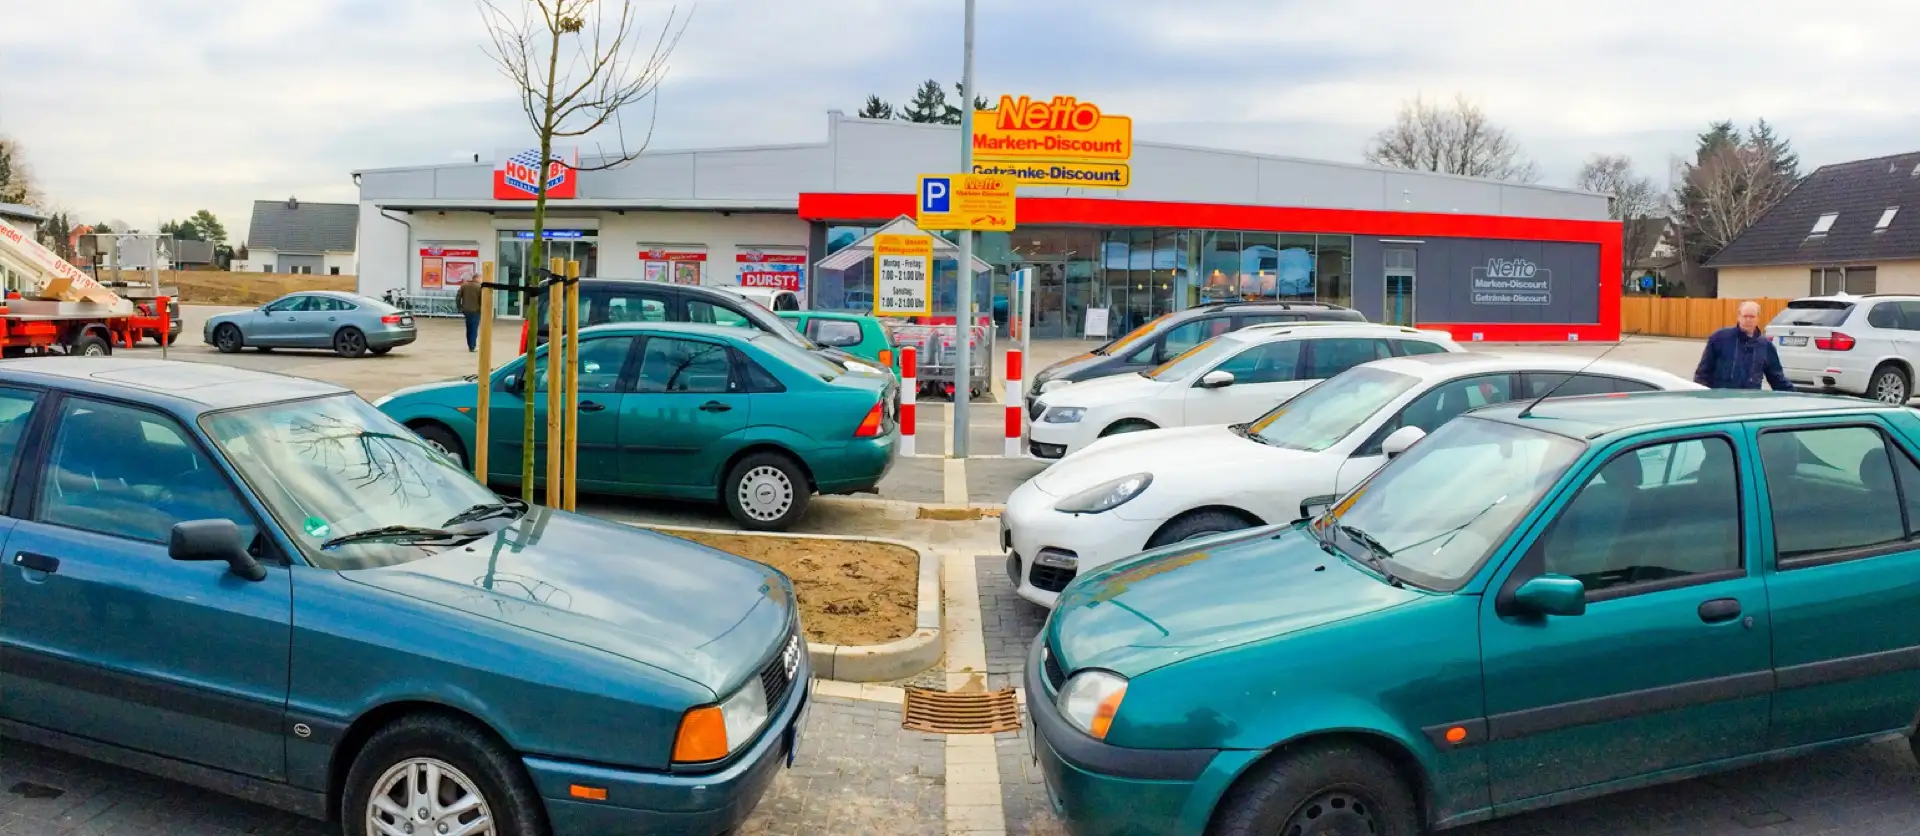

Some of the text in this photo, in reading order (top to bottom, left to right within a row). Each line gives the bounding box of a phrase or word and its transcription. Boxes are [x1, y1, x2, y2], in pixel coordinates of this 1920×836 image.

[997, 95, 1100, 131] Netto
[973, 134, 1122, 153] Marken-Discount
[973, 165, 1121, 181] Getränke-Discount
[965, 177, 1003, 190] Netto
[927, 182, 946, 209] P
[1487, 258, 1536, 277] Netto
[746, 274, 797, 287] DURST?
[1475, 279, 1547, 288] Marken-Discount
